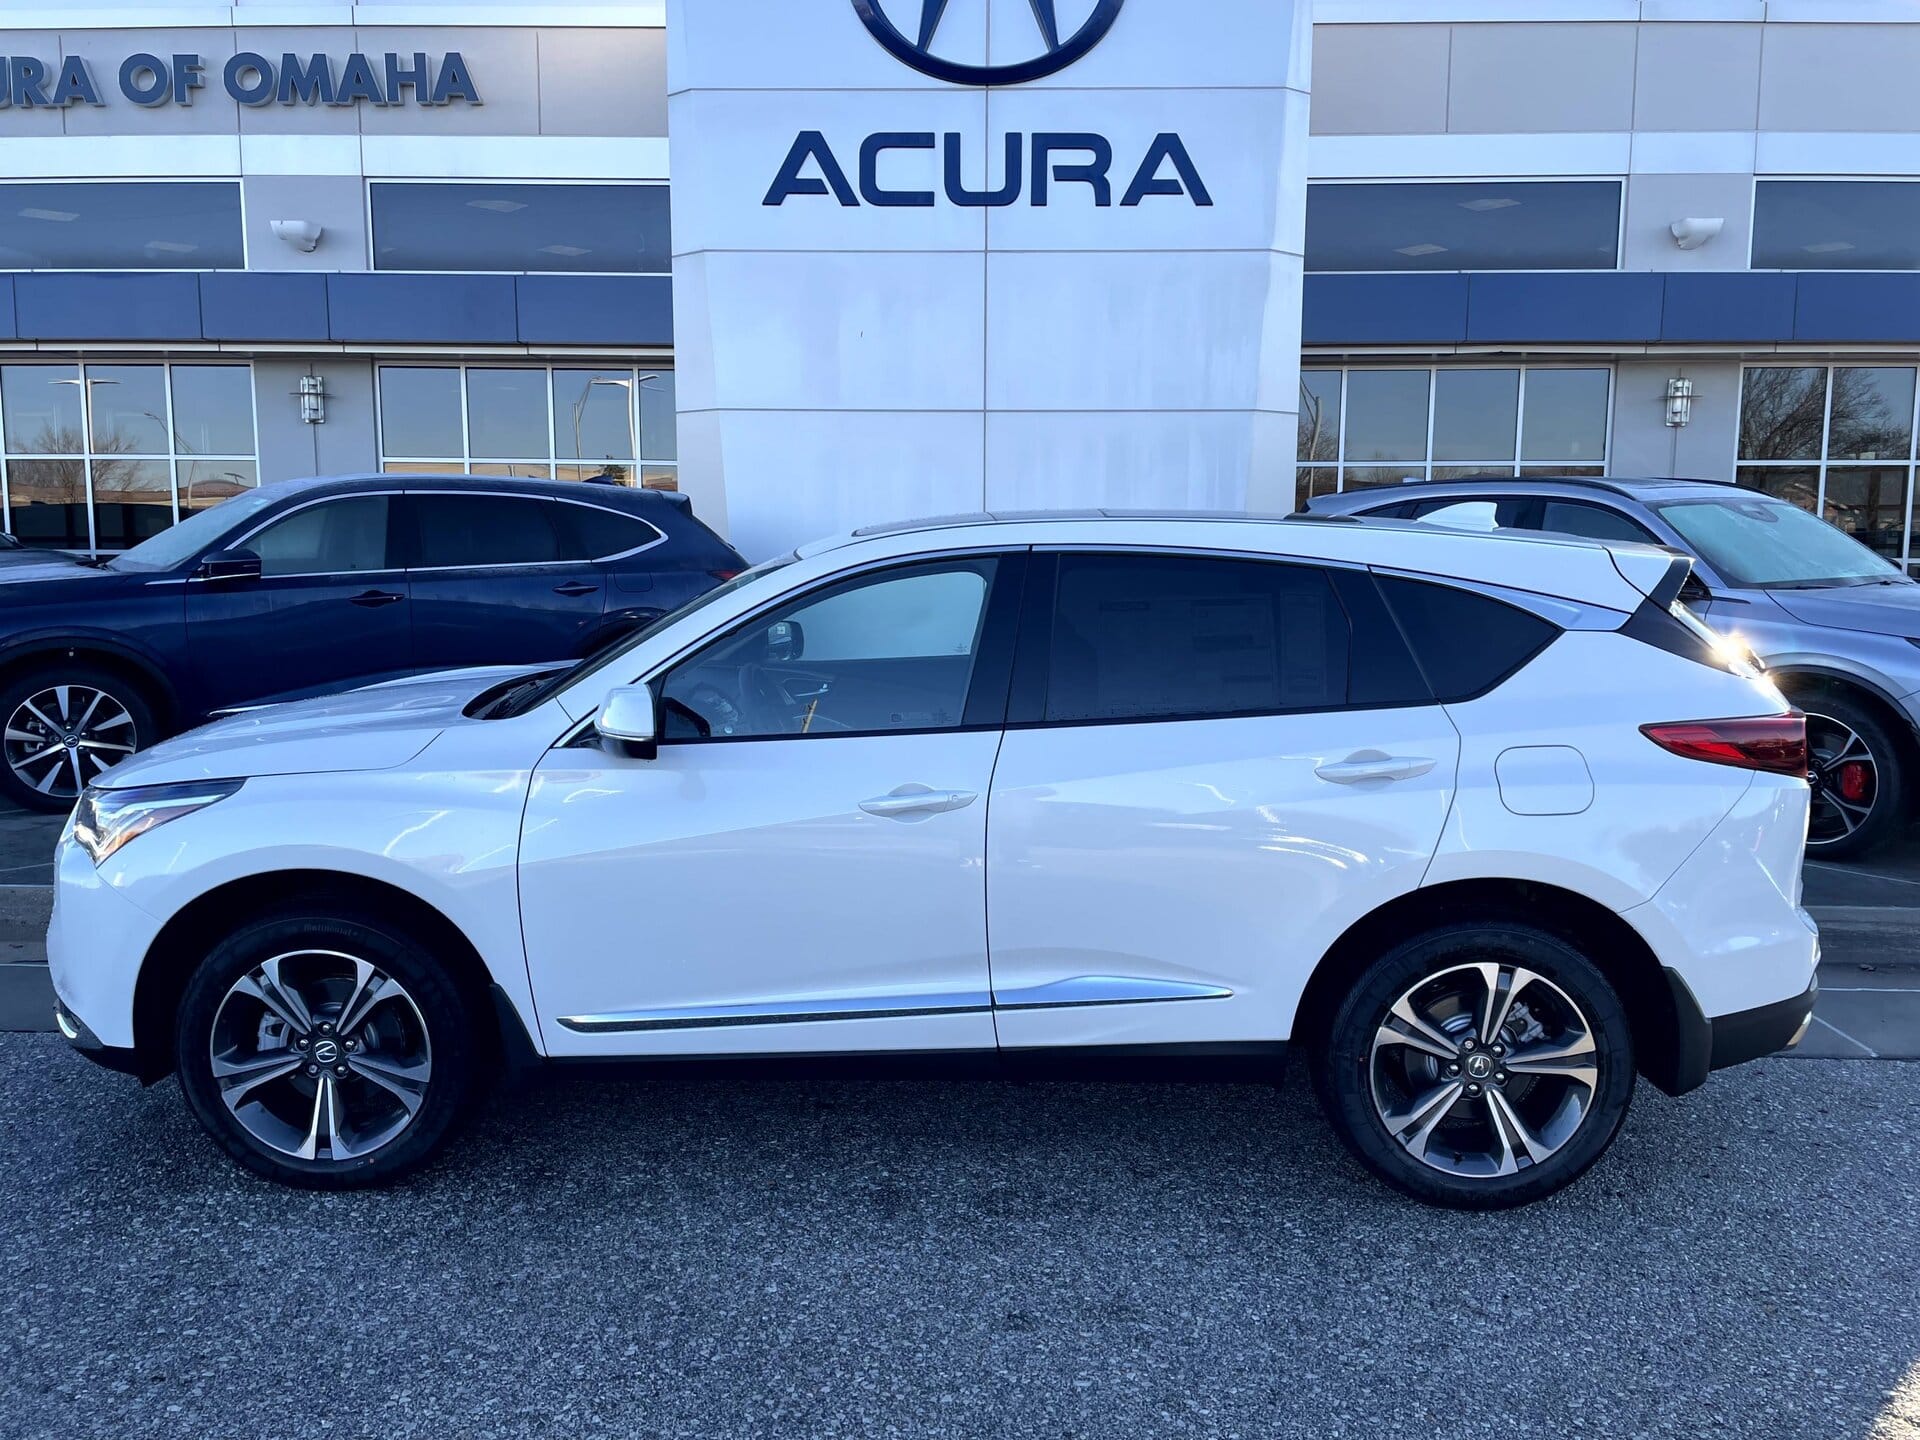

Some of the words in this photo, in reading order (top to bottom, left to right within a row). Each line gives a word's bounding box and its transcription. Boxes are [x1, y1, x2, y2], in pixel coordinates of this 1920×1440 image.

[0, 55, 102, 105] RA
[118, 53, 202, 105] OF
[223, 52, 481, 105] OMAHA
[762, 130, 1214, 207] ACURA
